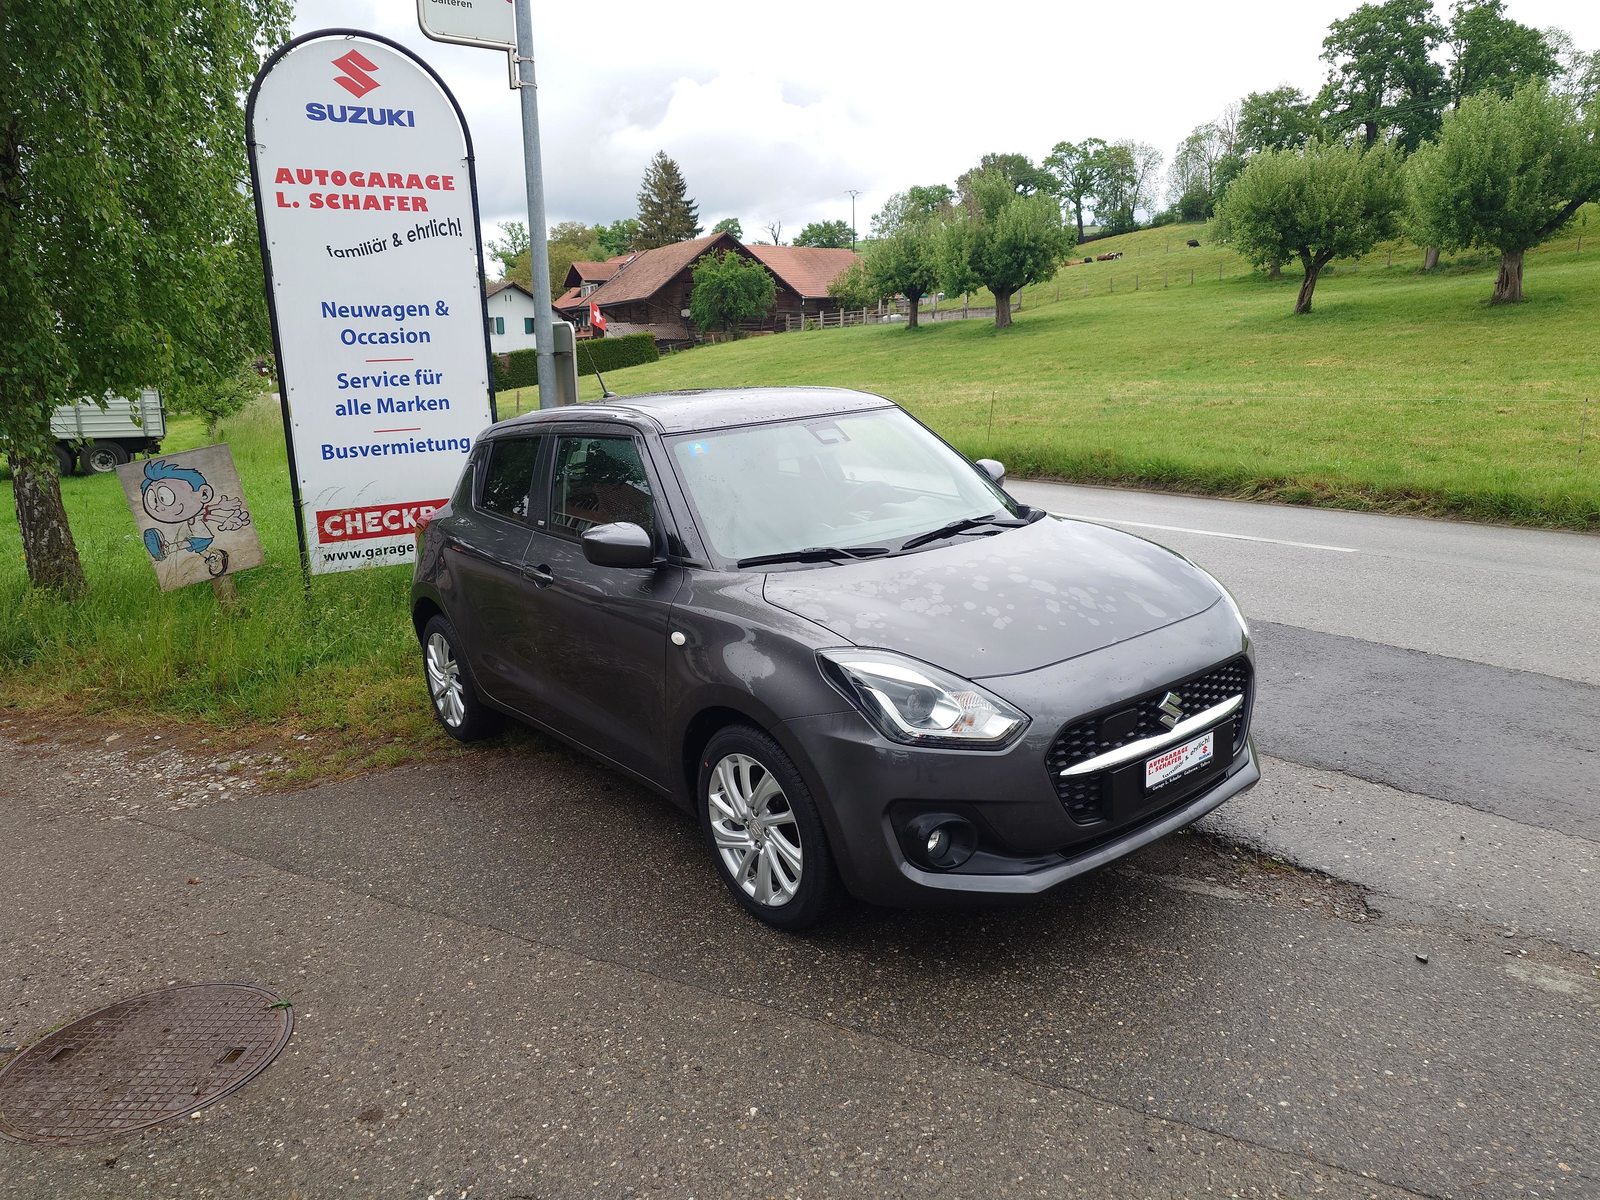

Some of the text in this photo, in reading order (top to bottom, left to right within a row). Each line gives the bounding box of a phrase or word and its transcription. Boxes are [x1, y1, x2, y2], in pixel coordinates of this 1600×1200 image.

[305, 102, 415, 128] SUZUKI
[275, 167, 455, 191] AUTOGARAGE
[276, 192, 429, 212] L. SCHAFER
[326, 217, 463, 258] familiär & ehrlich!
[321, 300, 450, 321] Neuwagen &
[340, 327, 431, 345] Occasion
[336, 369, 443, 389] Service für
[335, 396, 450, 416] alle Marken
[321, 437, 471, 460] Busvermietung
[323, 543, 415, 562] www.garage
[1148, 746, 1188, 769] AUTOGARAGE
